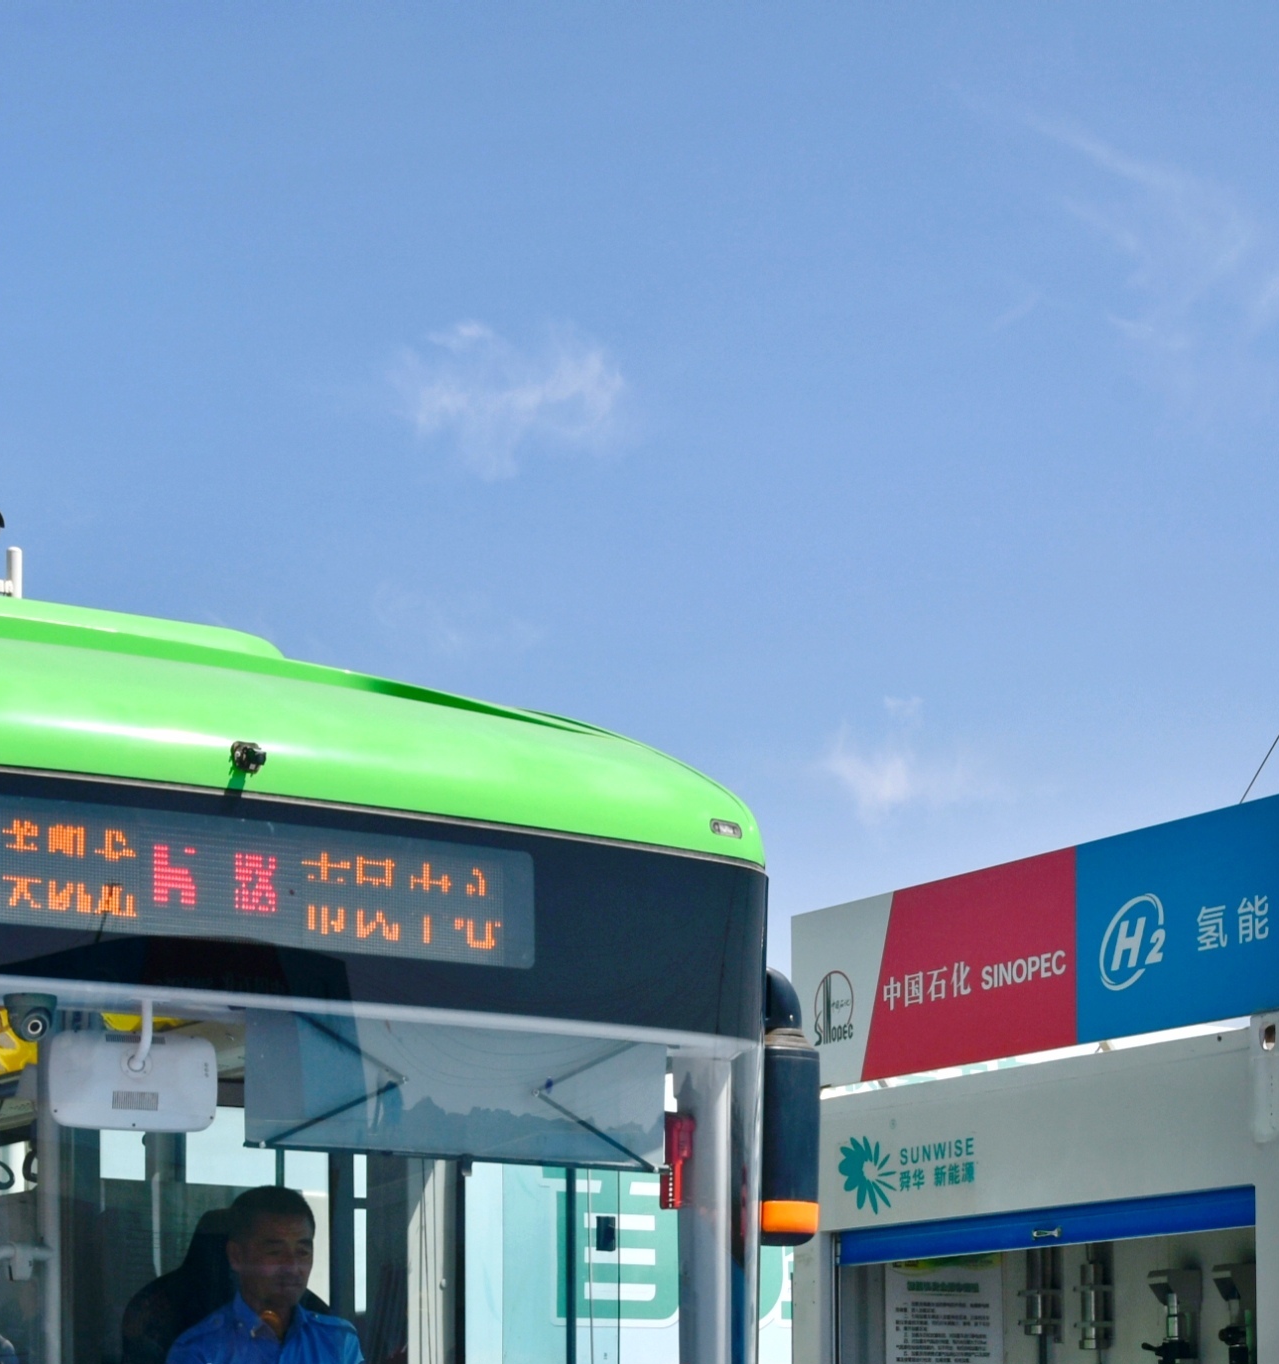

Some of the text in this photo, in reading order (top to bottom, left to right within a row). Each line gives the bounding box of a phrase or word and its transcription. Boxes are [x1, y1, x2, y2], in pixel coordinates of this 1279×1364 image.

[1196, 895, 1269, 951] 氢能
[883, 950, 1067, 1011] 中国石化 SINOPEC
[899, 1137, 975, 1166] SUNWISE
[899, 1162, 975, 1192] 舜华 新能源
